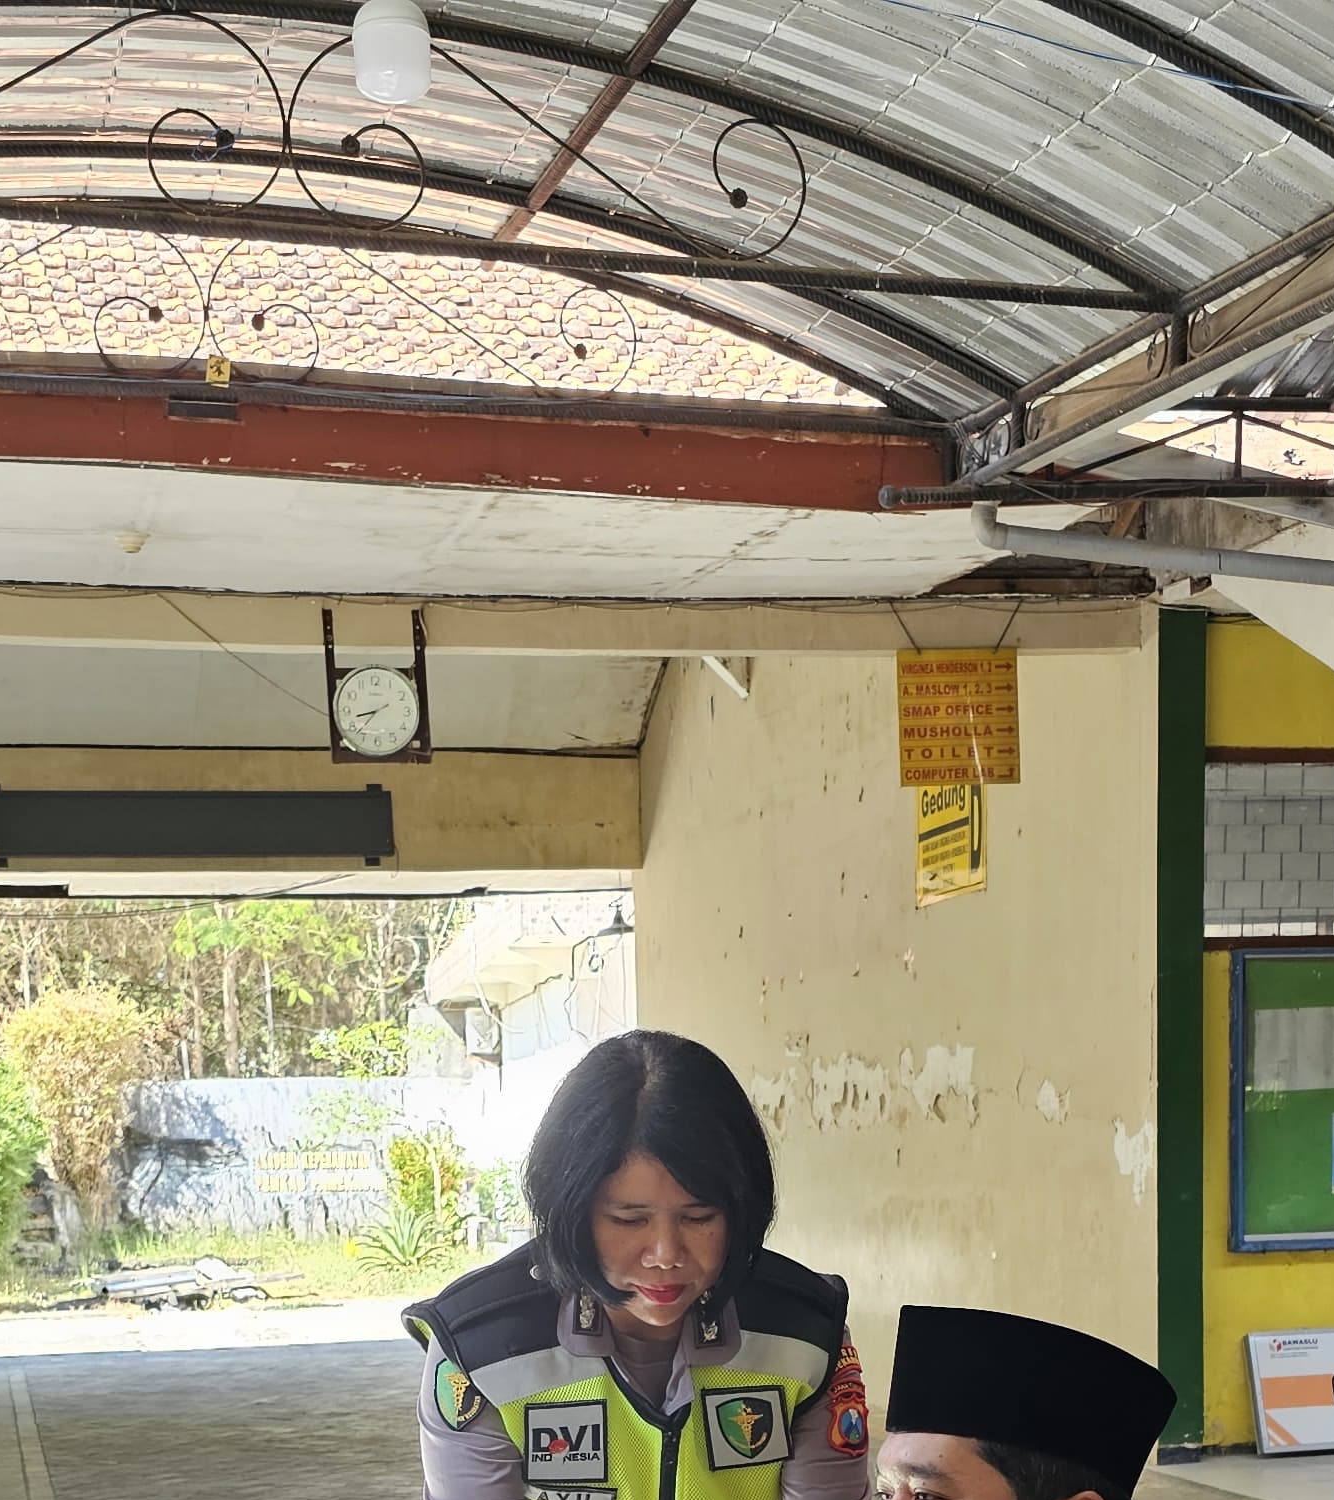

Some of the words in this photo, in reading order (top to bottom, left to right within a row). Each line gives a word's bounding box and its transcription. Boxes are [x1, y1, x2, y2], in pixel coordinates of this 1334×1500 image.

[903, 685, 913, 696] A.
[916, 684, 959, 696] MASLOW
[902, 705, 941, 717] SMAP
[945, 704, 993, 716] OFFICE
[903, 726, 993, 739] MUSHOLLA
[904, 746, 994, 760] TOILET
[905, 768, 969, 781] COMPUTER
[921, 784, 966, 818] Gedung
[532, 1423, 601, 1454] DVI
[531, 1452, 601, 1464] INDNESIA
